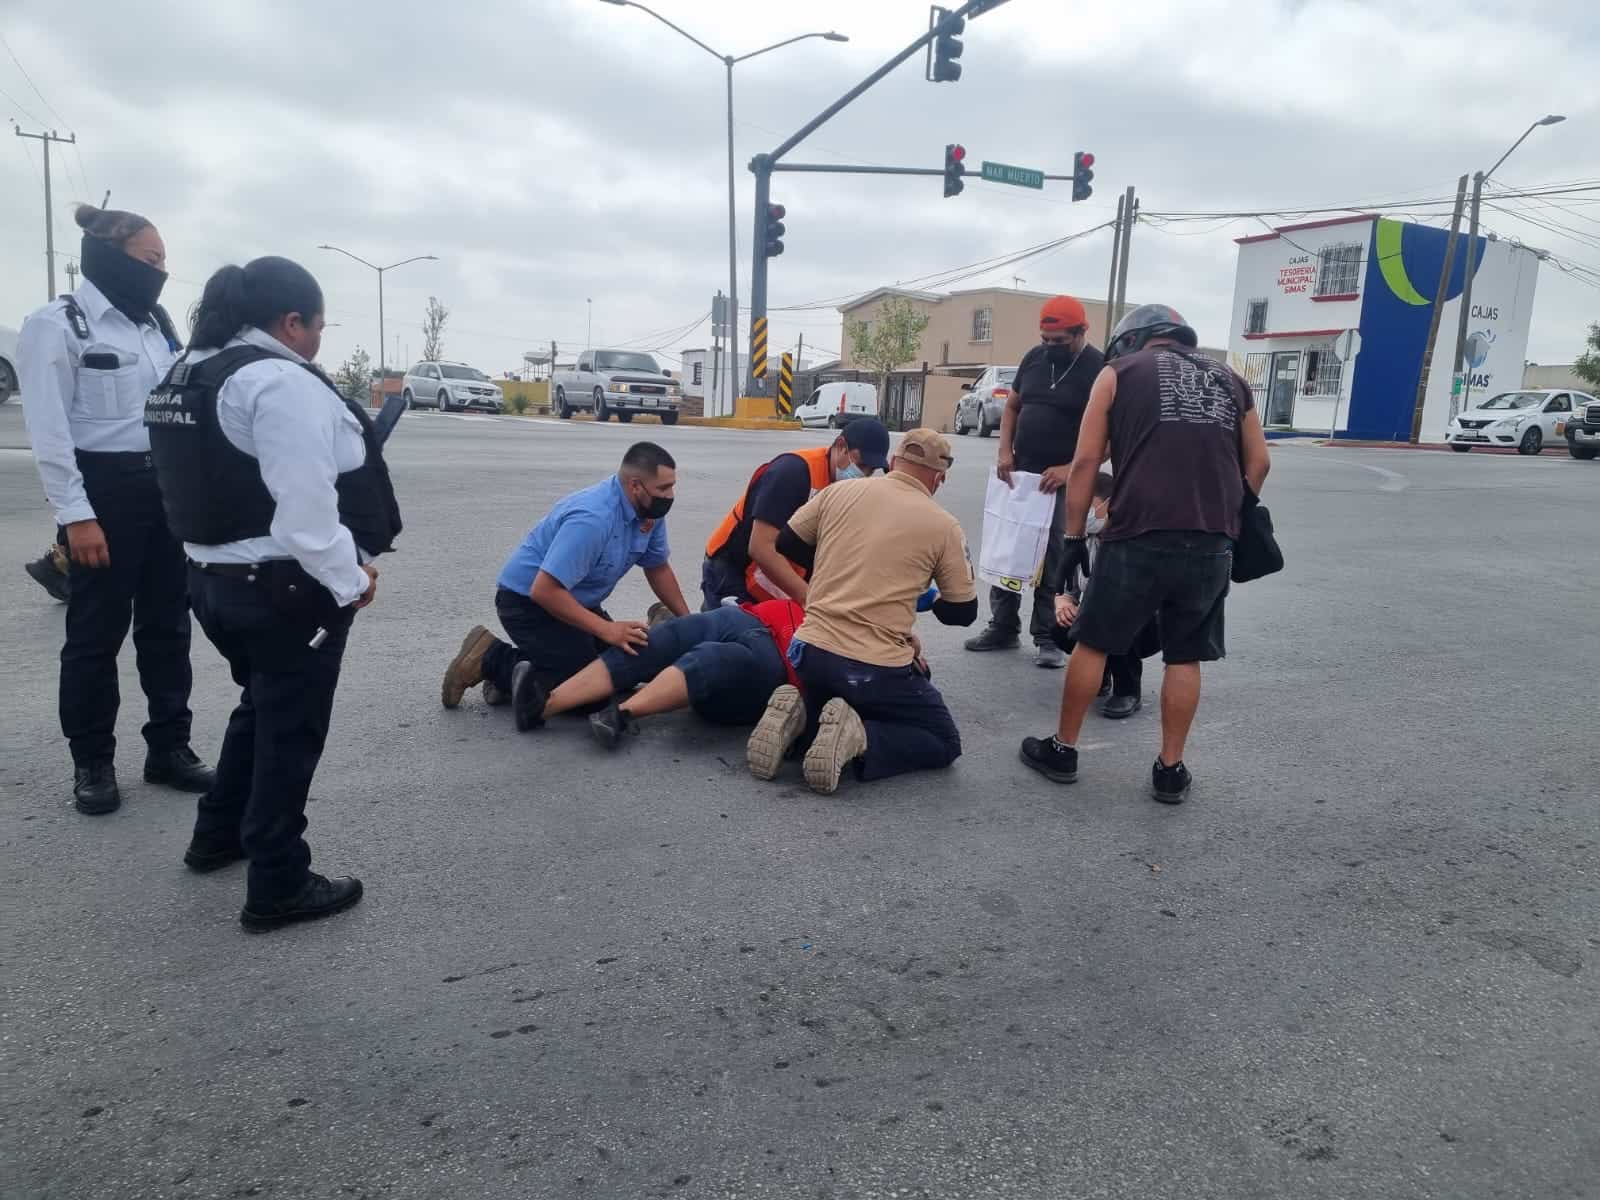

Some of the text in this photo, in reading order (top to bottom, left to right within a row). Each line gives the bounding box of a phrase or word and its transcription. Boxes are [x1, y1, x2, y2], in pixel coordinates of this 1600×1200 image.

[1007, 167, 1040, 185] MUERTO
[1288, 255, 1309, 265] CAJAS
[1277, 275, 1313, 286] MUNICIPAL
[1284, 284, 1306, 294] SIMAS
[1471, 305, 1499, 321] CAJAS
